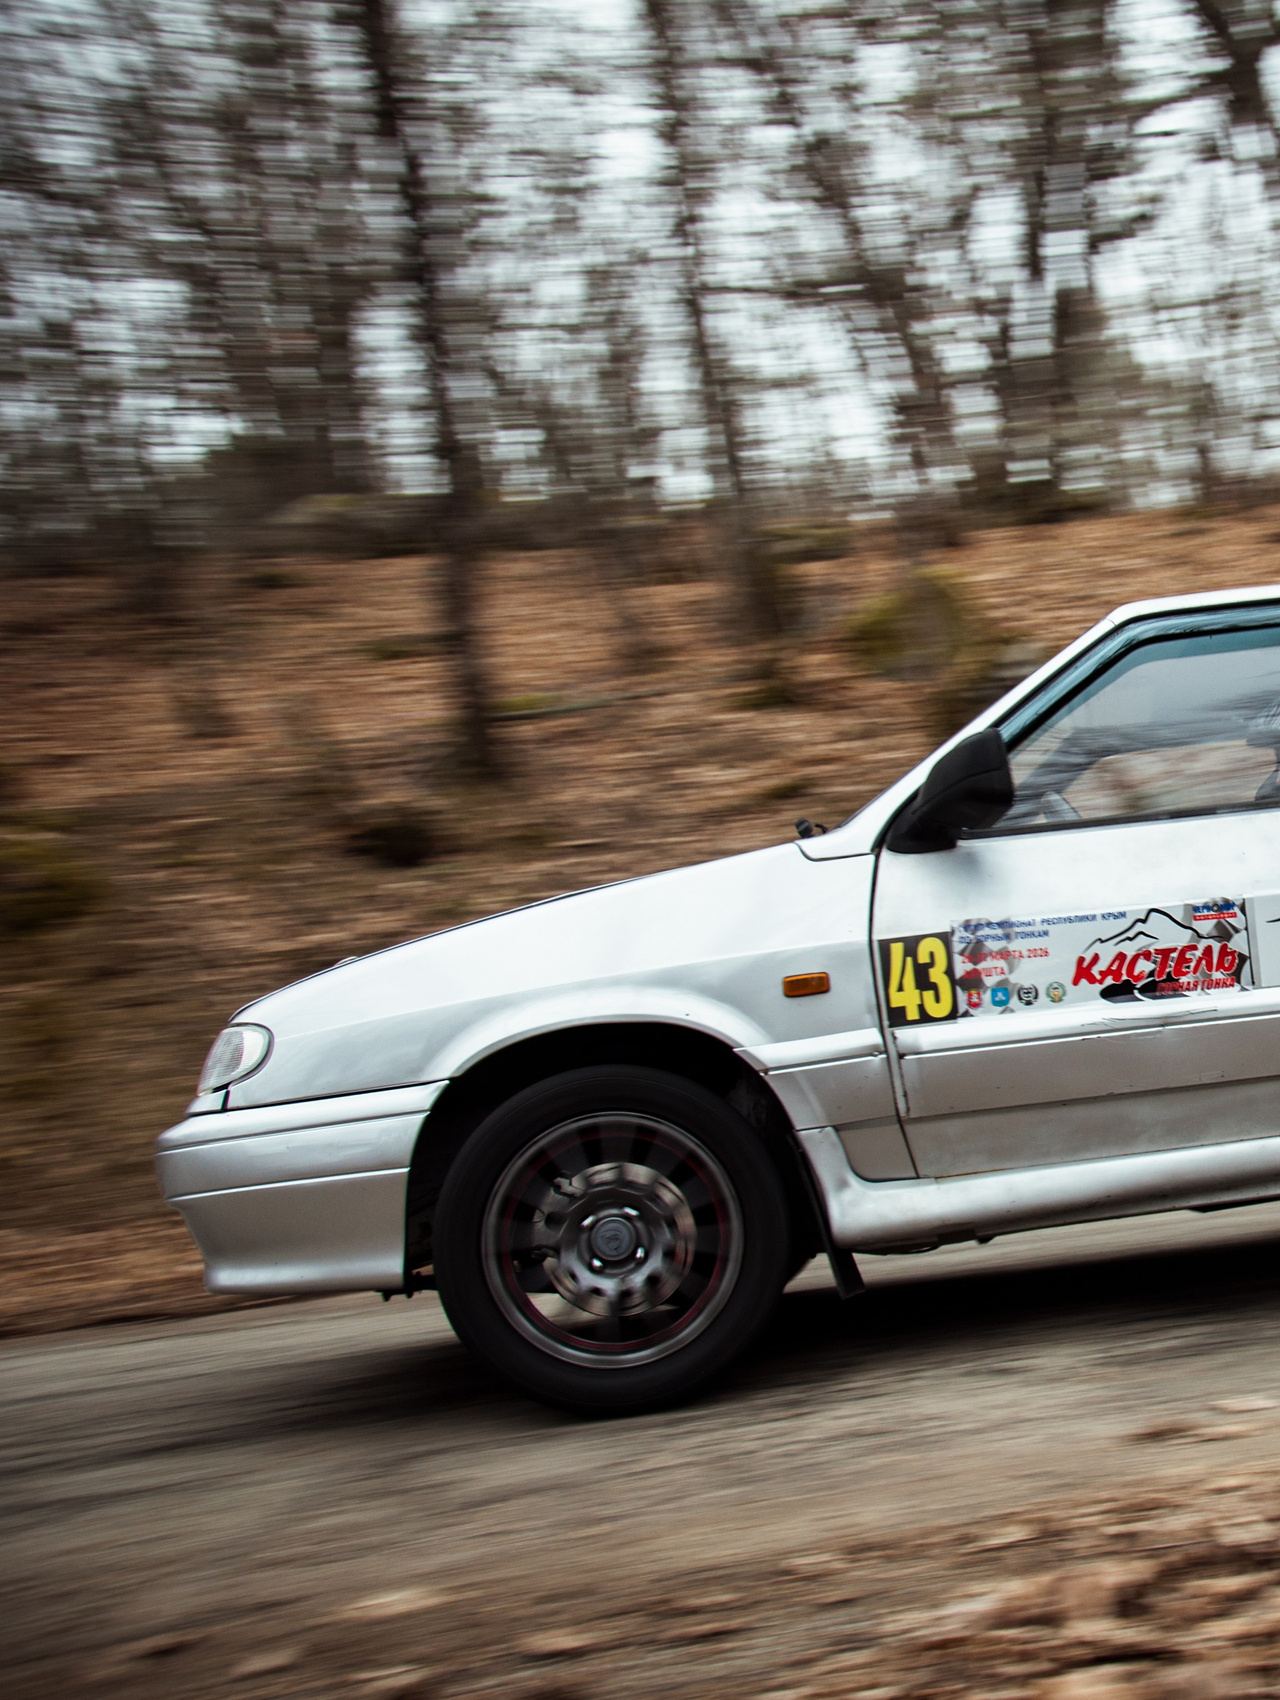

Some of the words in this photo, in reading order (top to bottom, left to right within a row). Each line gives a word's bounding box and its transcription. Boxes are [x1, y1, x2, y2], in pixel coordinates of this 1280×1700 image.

[1041, 914, 1097, 925] РЕСПУБЛИКИ
[1101, 911, 1127, 921] КРЫМ
[1015, 929, 1049, 940] ГОНКАМ
[1072, 942, 1239, 986] КАСТЕЛЬ
[888, 936, 955, 1021] 43
[1155, 980, 1199, 995] ГОРНАЯ
[1201, 976, 1235, 991] ГОНКА
